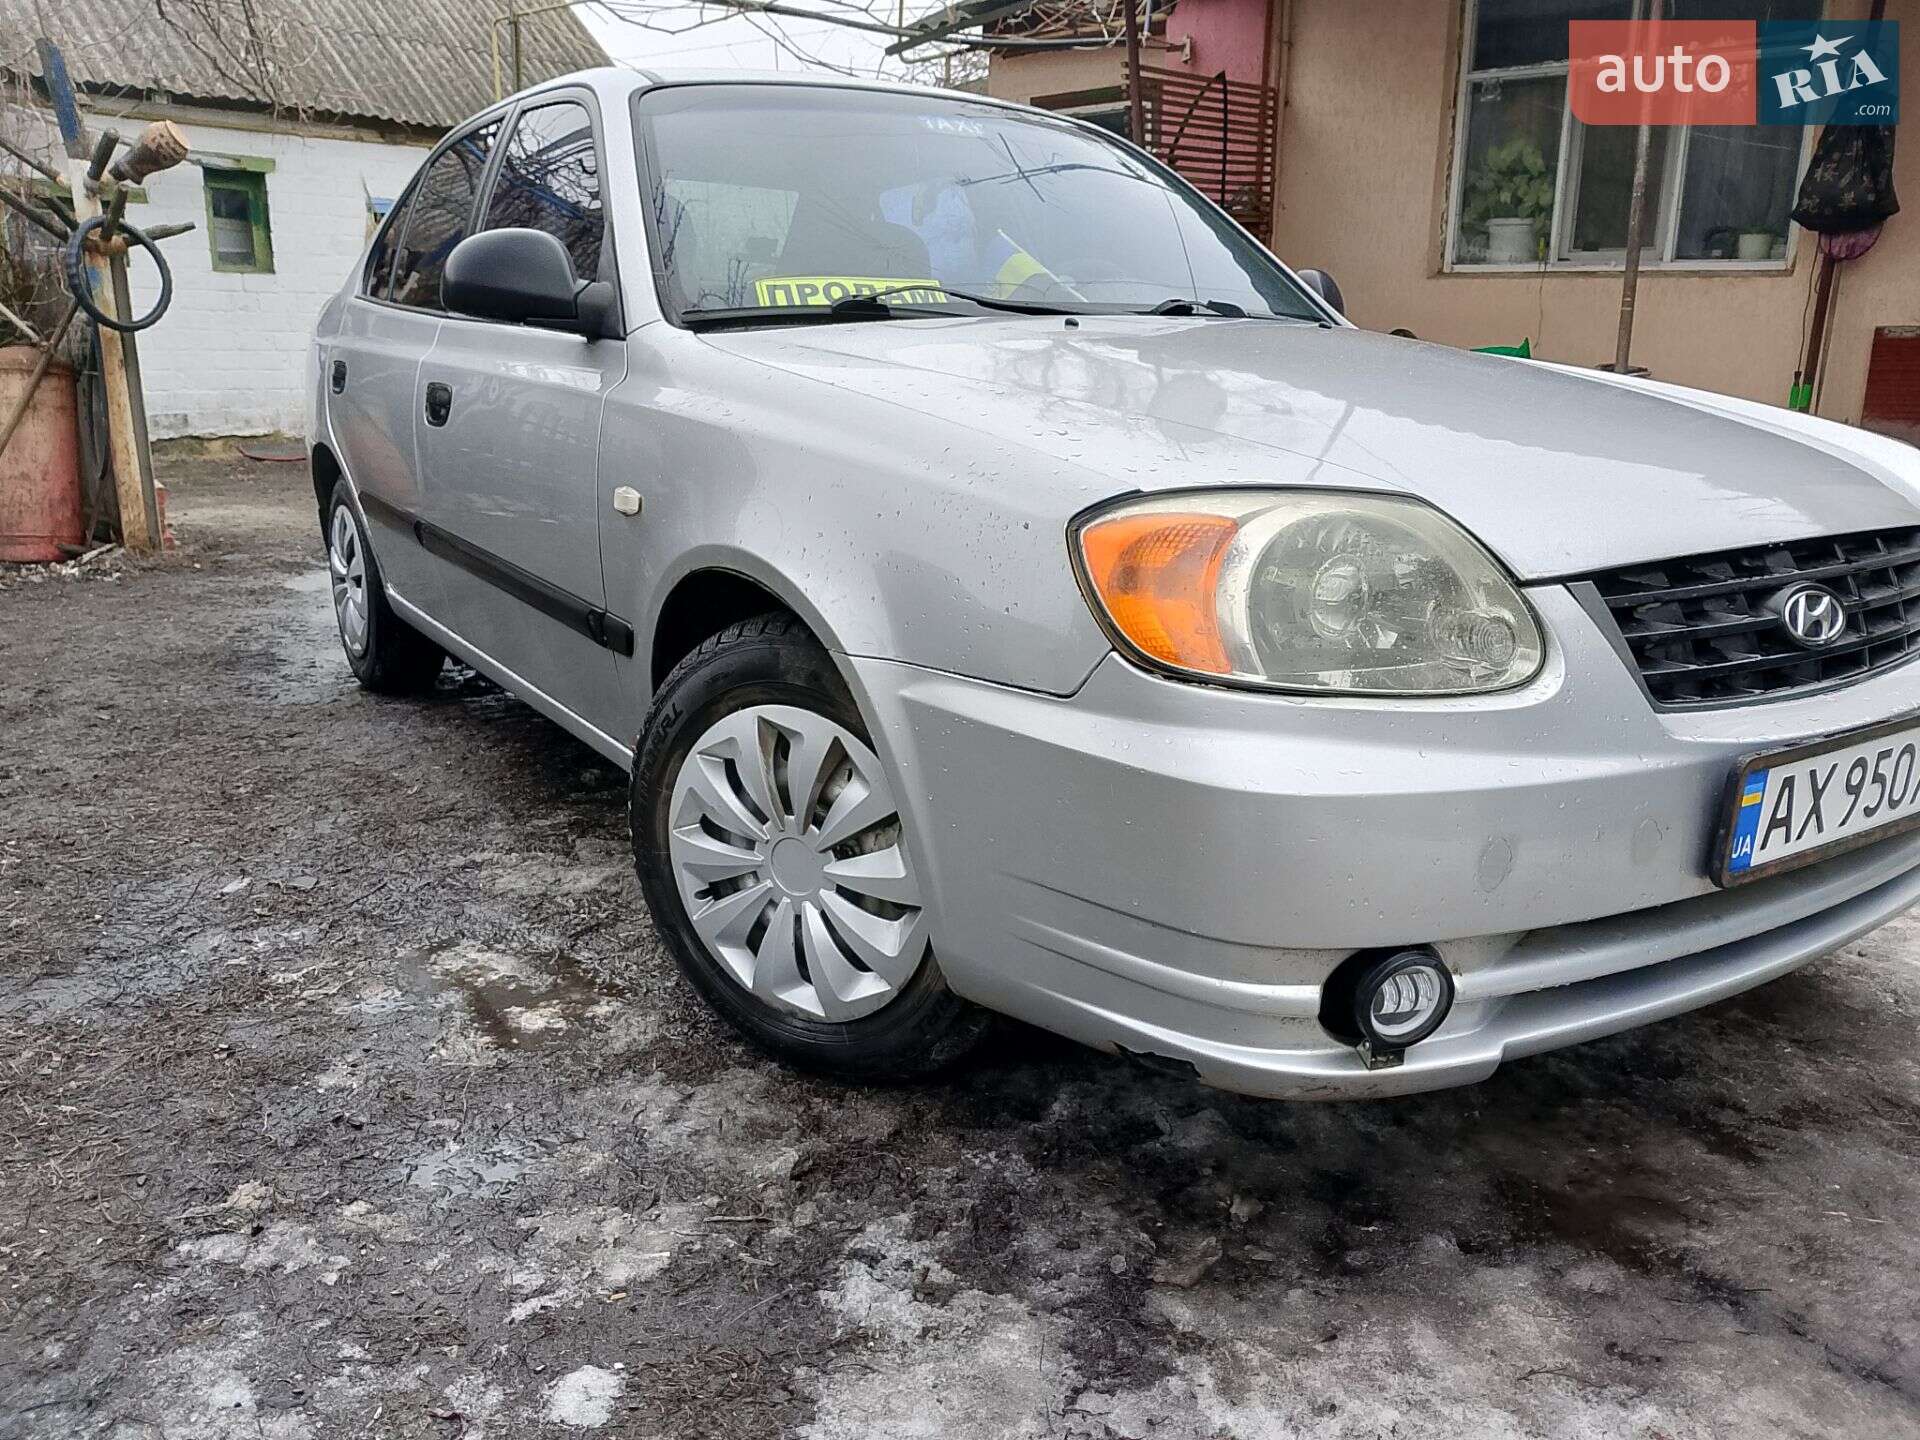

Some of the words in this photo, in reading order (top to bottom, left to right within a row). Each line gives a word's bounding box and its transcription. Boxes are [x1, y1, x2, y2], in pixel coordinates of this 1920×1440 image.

[1759, 763, 1839, 850] AX
[1838, 742, 1920, 828] 950
[1731, 834, 1751, 858] UA
